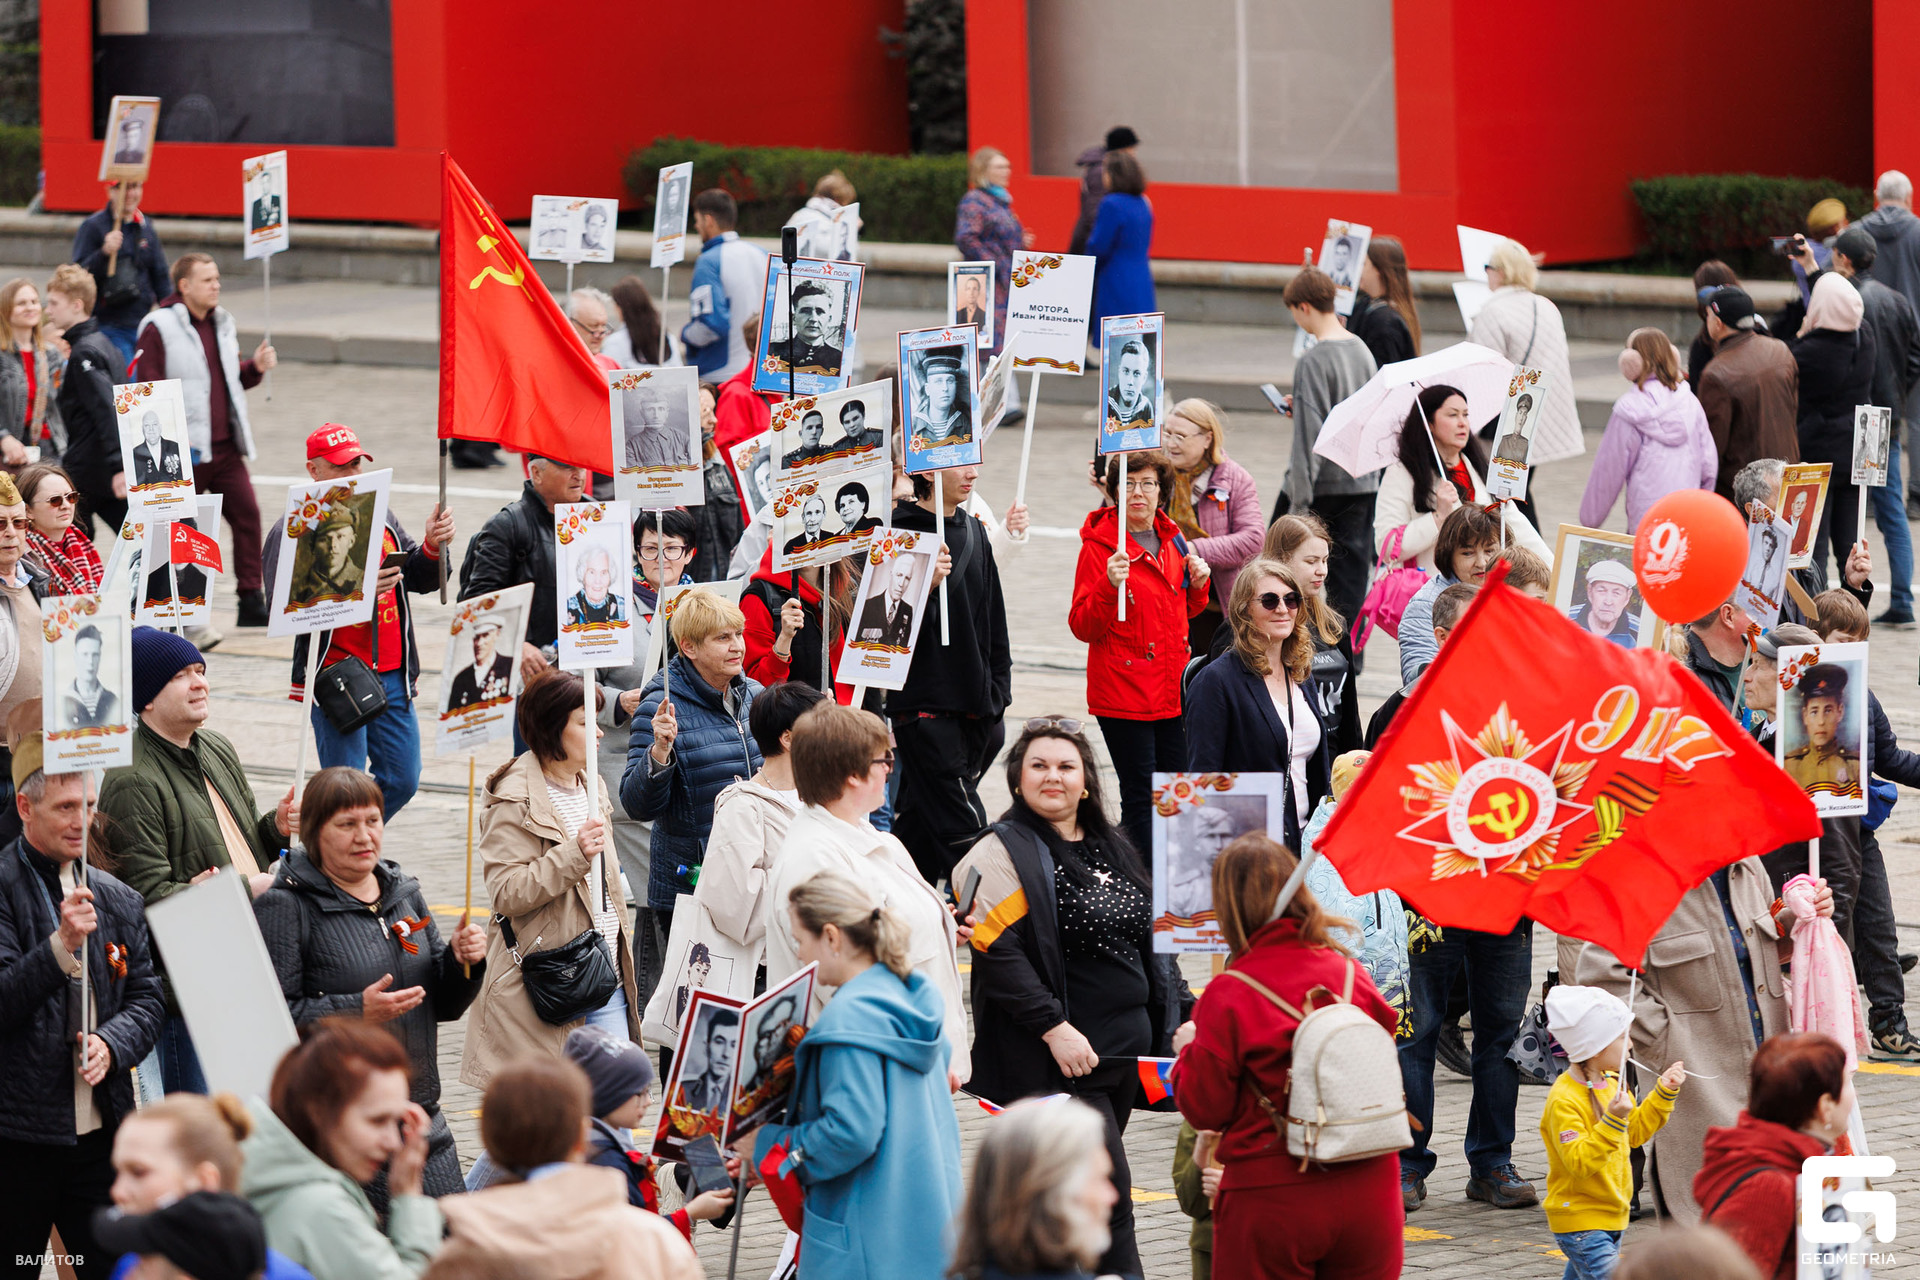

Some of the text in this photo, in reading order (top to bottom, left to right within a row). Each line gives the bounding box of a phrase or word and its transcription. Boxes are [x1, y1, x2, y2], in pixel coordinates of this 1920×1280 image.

[1028, 304, 1070, 314] МОТОРА
[1012, 312, 1085, 324] Иван Иванович
[1575, 685, 1640, 753] 9
